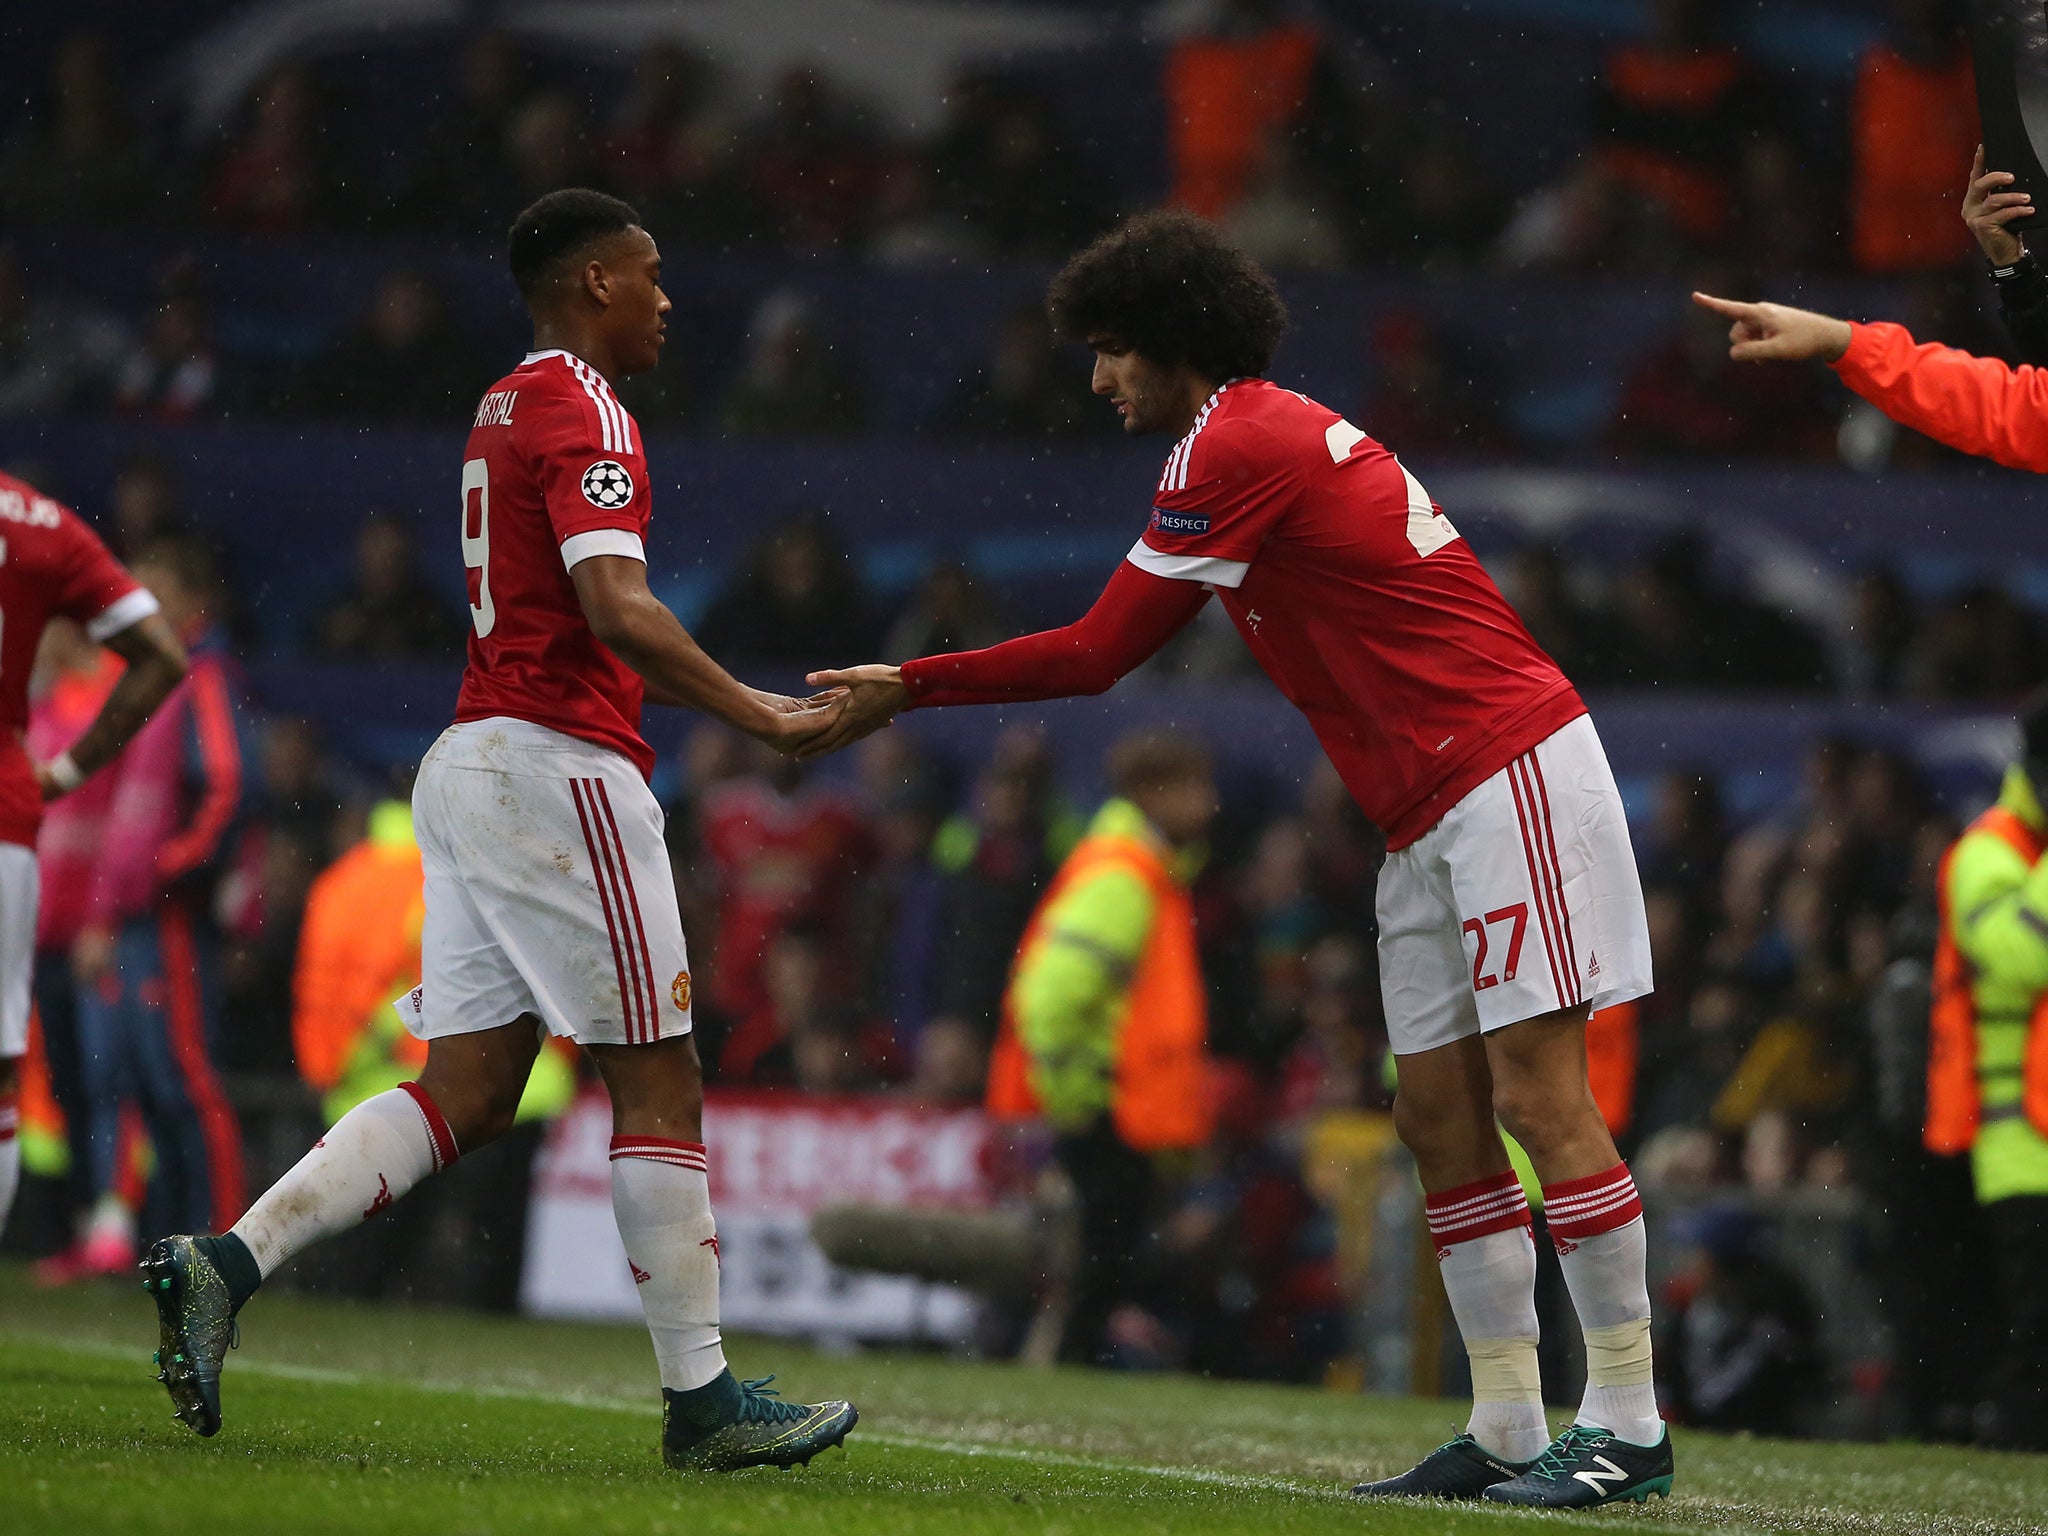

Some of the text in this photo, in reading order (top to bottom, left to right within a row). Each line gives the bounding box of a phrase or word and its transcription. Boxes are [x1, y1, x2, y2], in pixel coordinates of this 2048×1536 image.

[473, 390, 518, 428] ARTIAL
[1161, 515, 1210, 530] RESPECT
[461, 457, 496, 639] 9
[1462, 901, 1529, 992] 27
[1486, 1459, 1520, 1479] new balan
